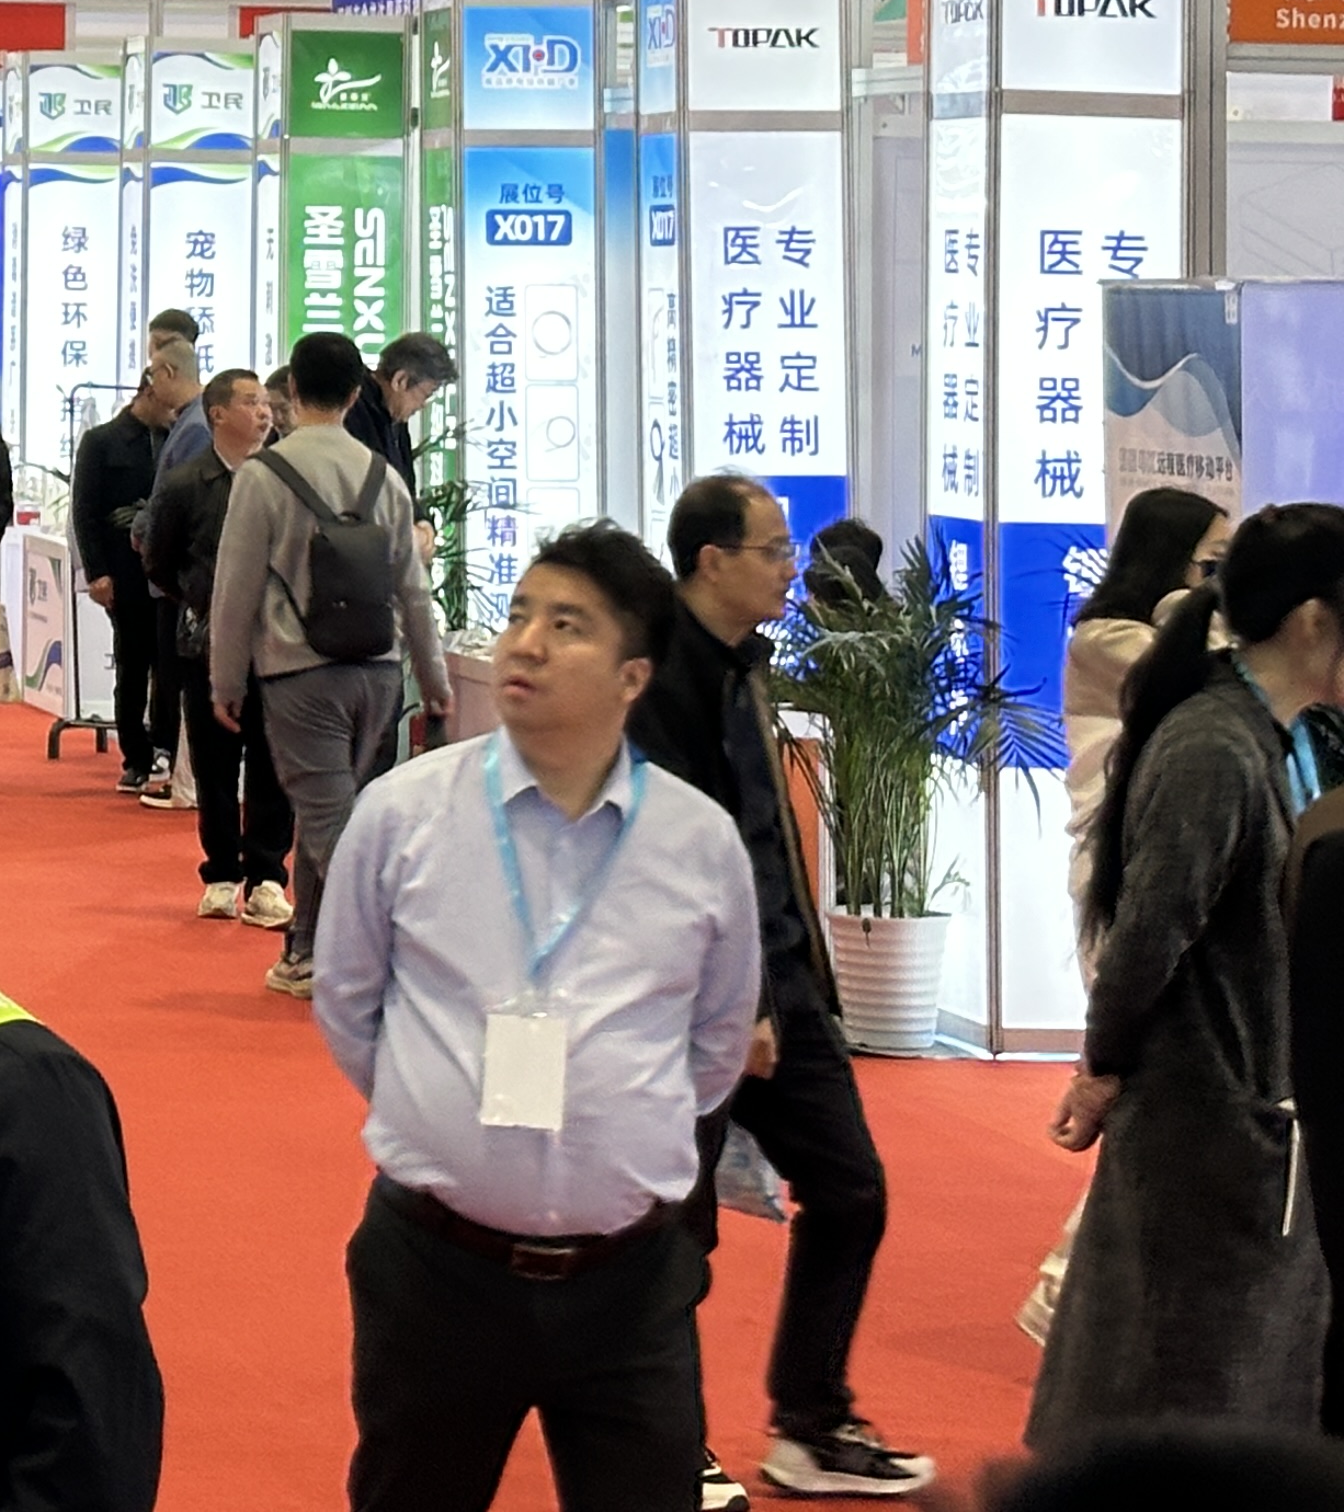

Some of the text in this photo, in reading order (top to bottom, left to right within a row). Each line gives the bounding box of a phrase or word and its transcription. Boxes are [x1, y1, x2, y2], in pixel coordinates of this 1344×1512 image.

[201, 91, 244, 110] 卫民
[707, 26, 820, 49] TOPAK
[73, 98, 113, 116] 卫民
[493, 214, 566, 242] X017
[499, 183, 566, 205] 展位号
[1101, 229, 1149, 279] 专
[60, 224, 89, 368] 绿色环保
[302, 205, 345, 333] 圣雪兰
[722, 225, 765, 457] 医疗器械
[775, 225, 820, 457] 专业定制
[940, 228, 961, 496] 医疗器械
[962, 227, 981, 498] 专业定制
[1034, 229, 1084, 499] 医疗器械
